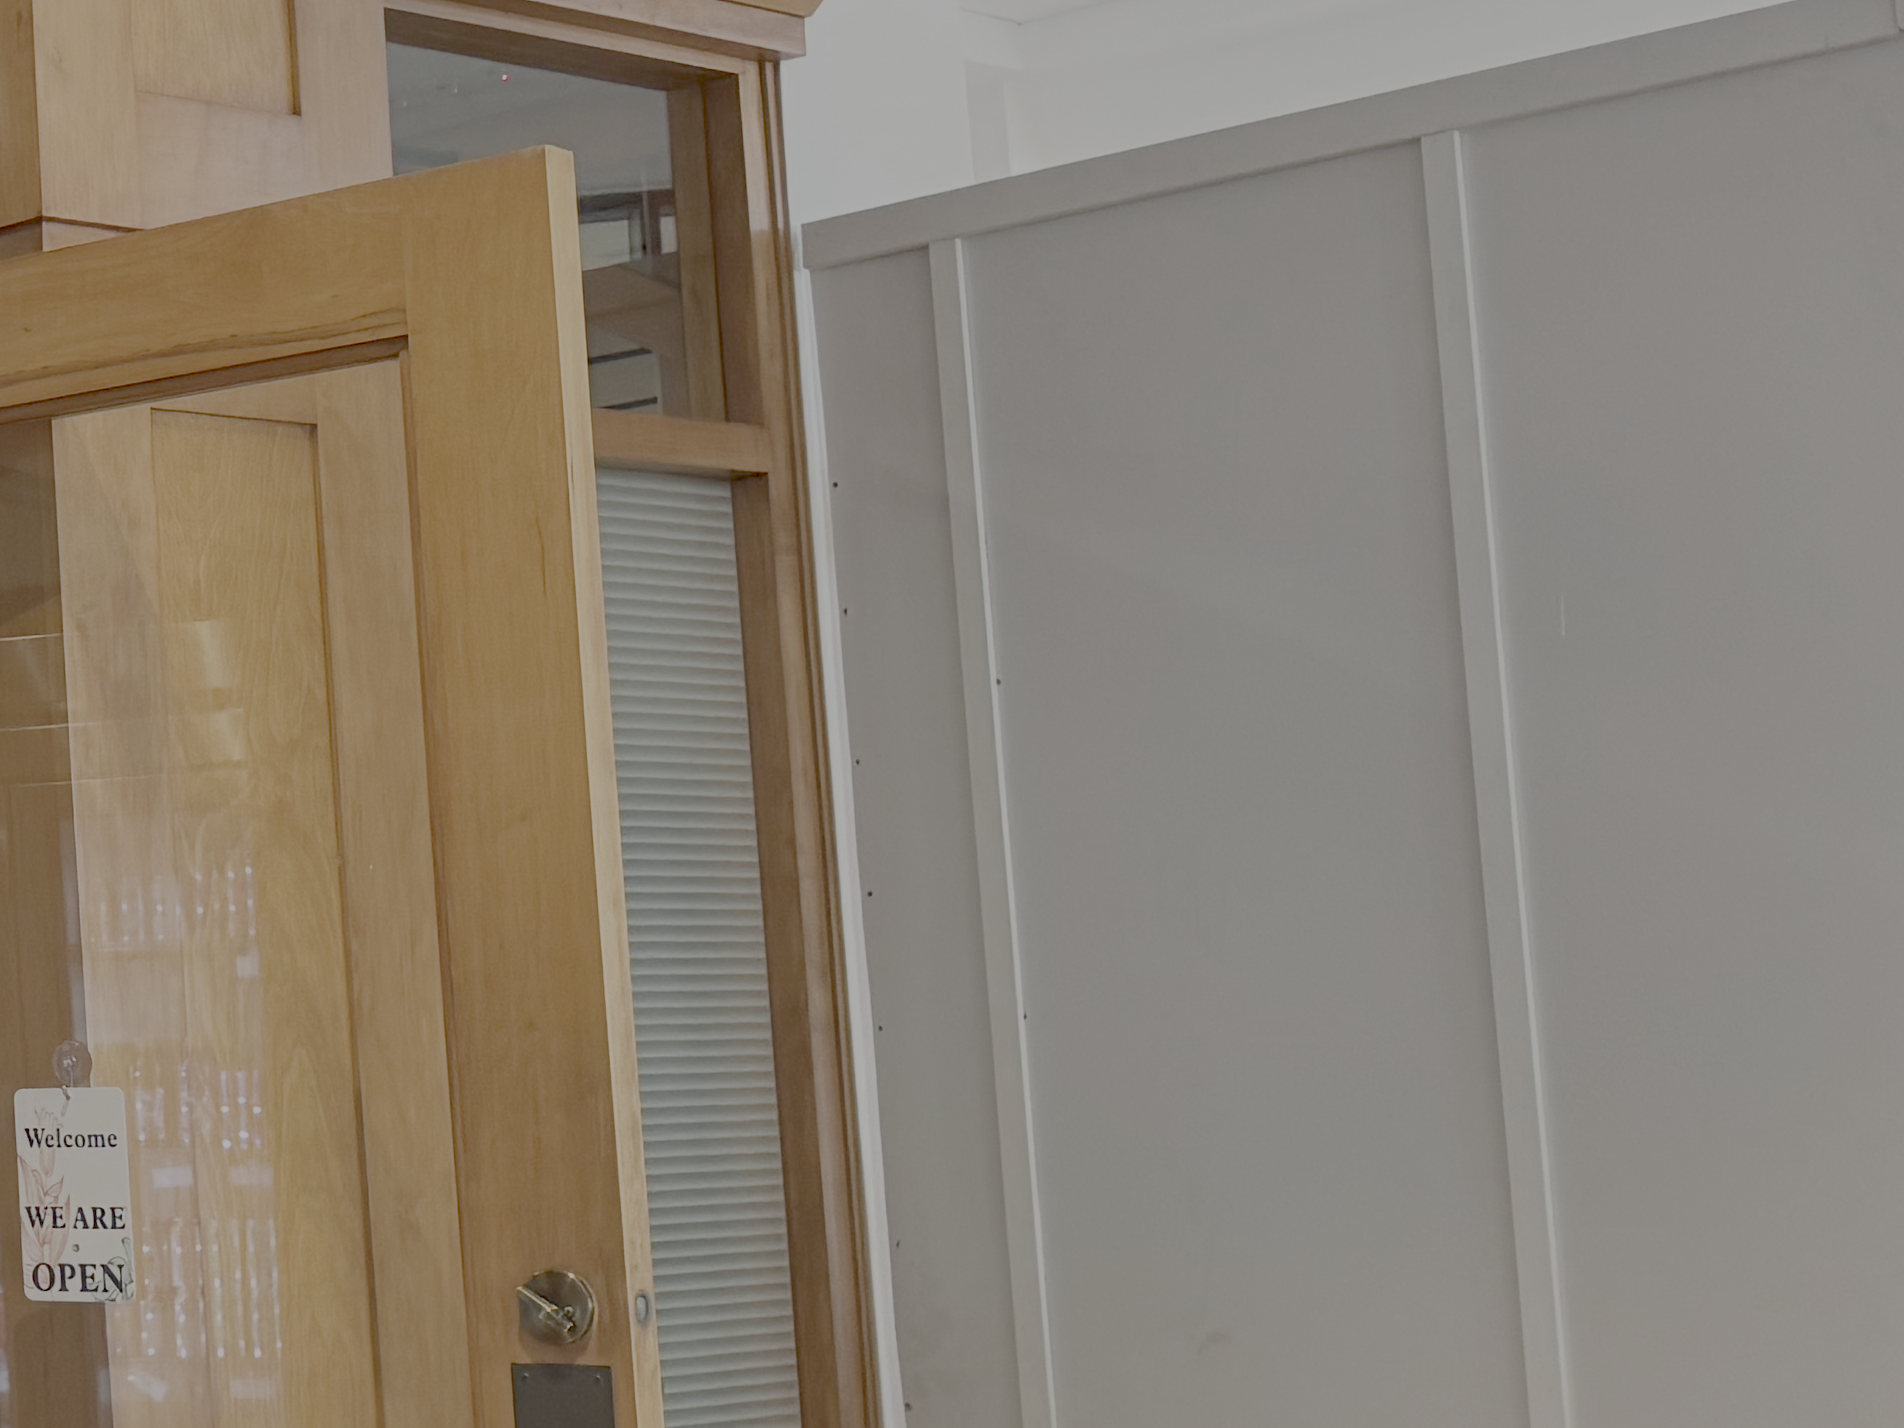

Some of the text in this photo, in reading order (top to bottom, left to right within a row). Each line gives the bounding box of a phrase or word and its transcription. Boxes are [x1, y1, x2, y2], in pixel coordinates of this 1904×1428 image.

[24, 1128, 118, 1148] Welcome
[25, 1206, 126, 1230] WE ARE
[32, 1263, 125, 1293] OPEN
